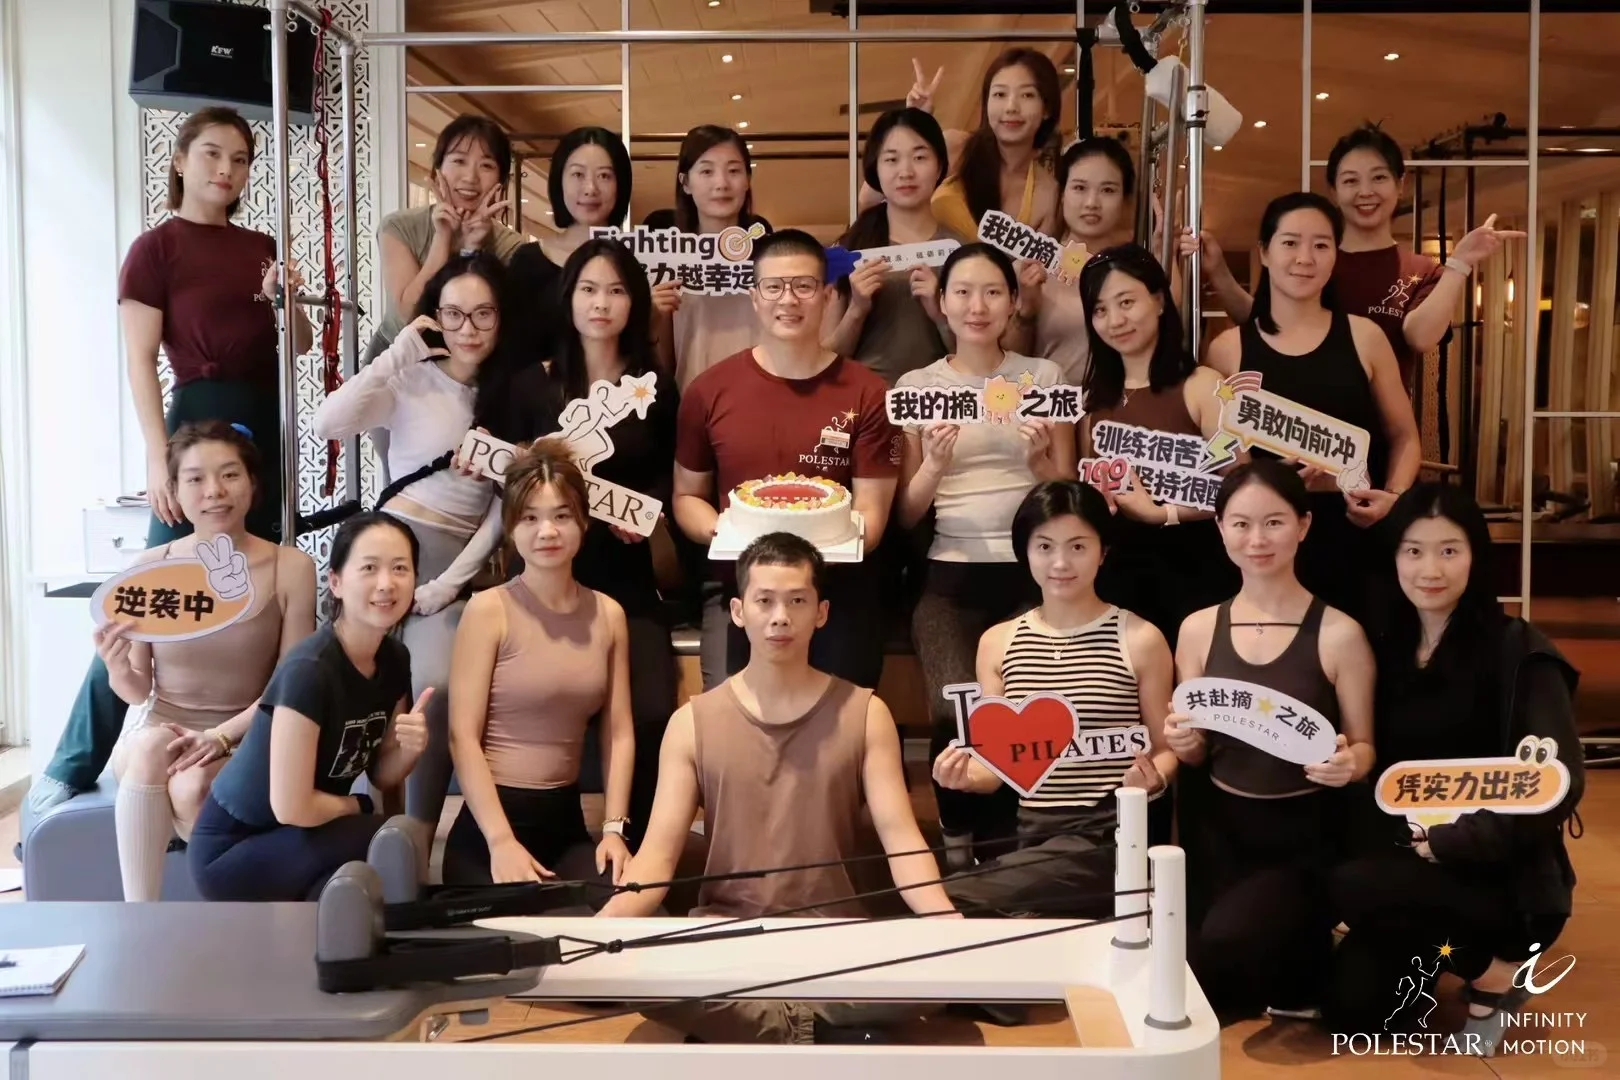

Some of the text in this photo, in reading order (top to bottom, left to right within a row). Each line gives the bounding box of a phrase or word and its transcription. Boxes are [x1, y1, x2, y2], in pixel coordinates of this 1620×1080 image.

[982, 213, 1058, 269] 我的摘
[640, 262, 755, 292] 力越幸运
[1368, 305, 1405, 319] POLEST
[891, 386, 1079, 421] 我的摘 之旅
[1096, 424, 1202, 469] 训练很苦
[1237, 394, 1357, 465] 勇敢向前冲
[466, 437, 645, 527] POTAR
[114, 585, 215, 622] 逆袭中
[948, 689, 1147, 763] I PILATES
[1186, 688, 1321, 741] 共赴摘 之旅
[1213, 713, 1280, 742] POLESTAR
[1394, 770, 1541, 803] 凭实力出彩
